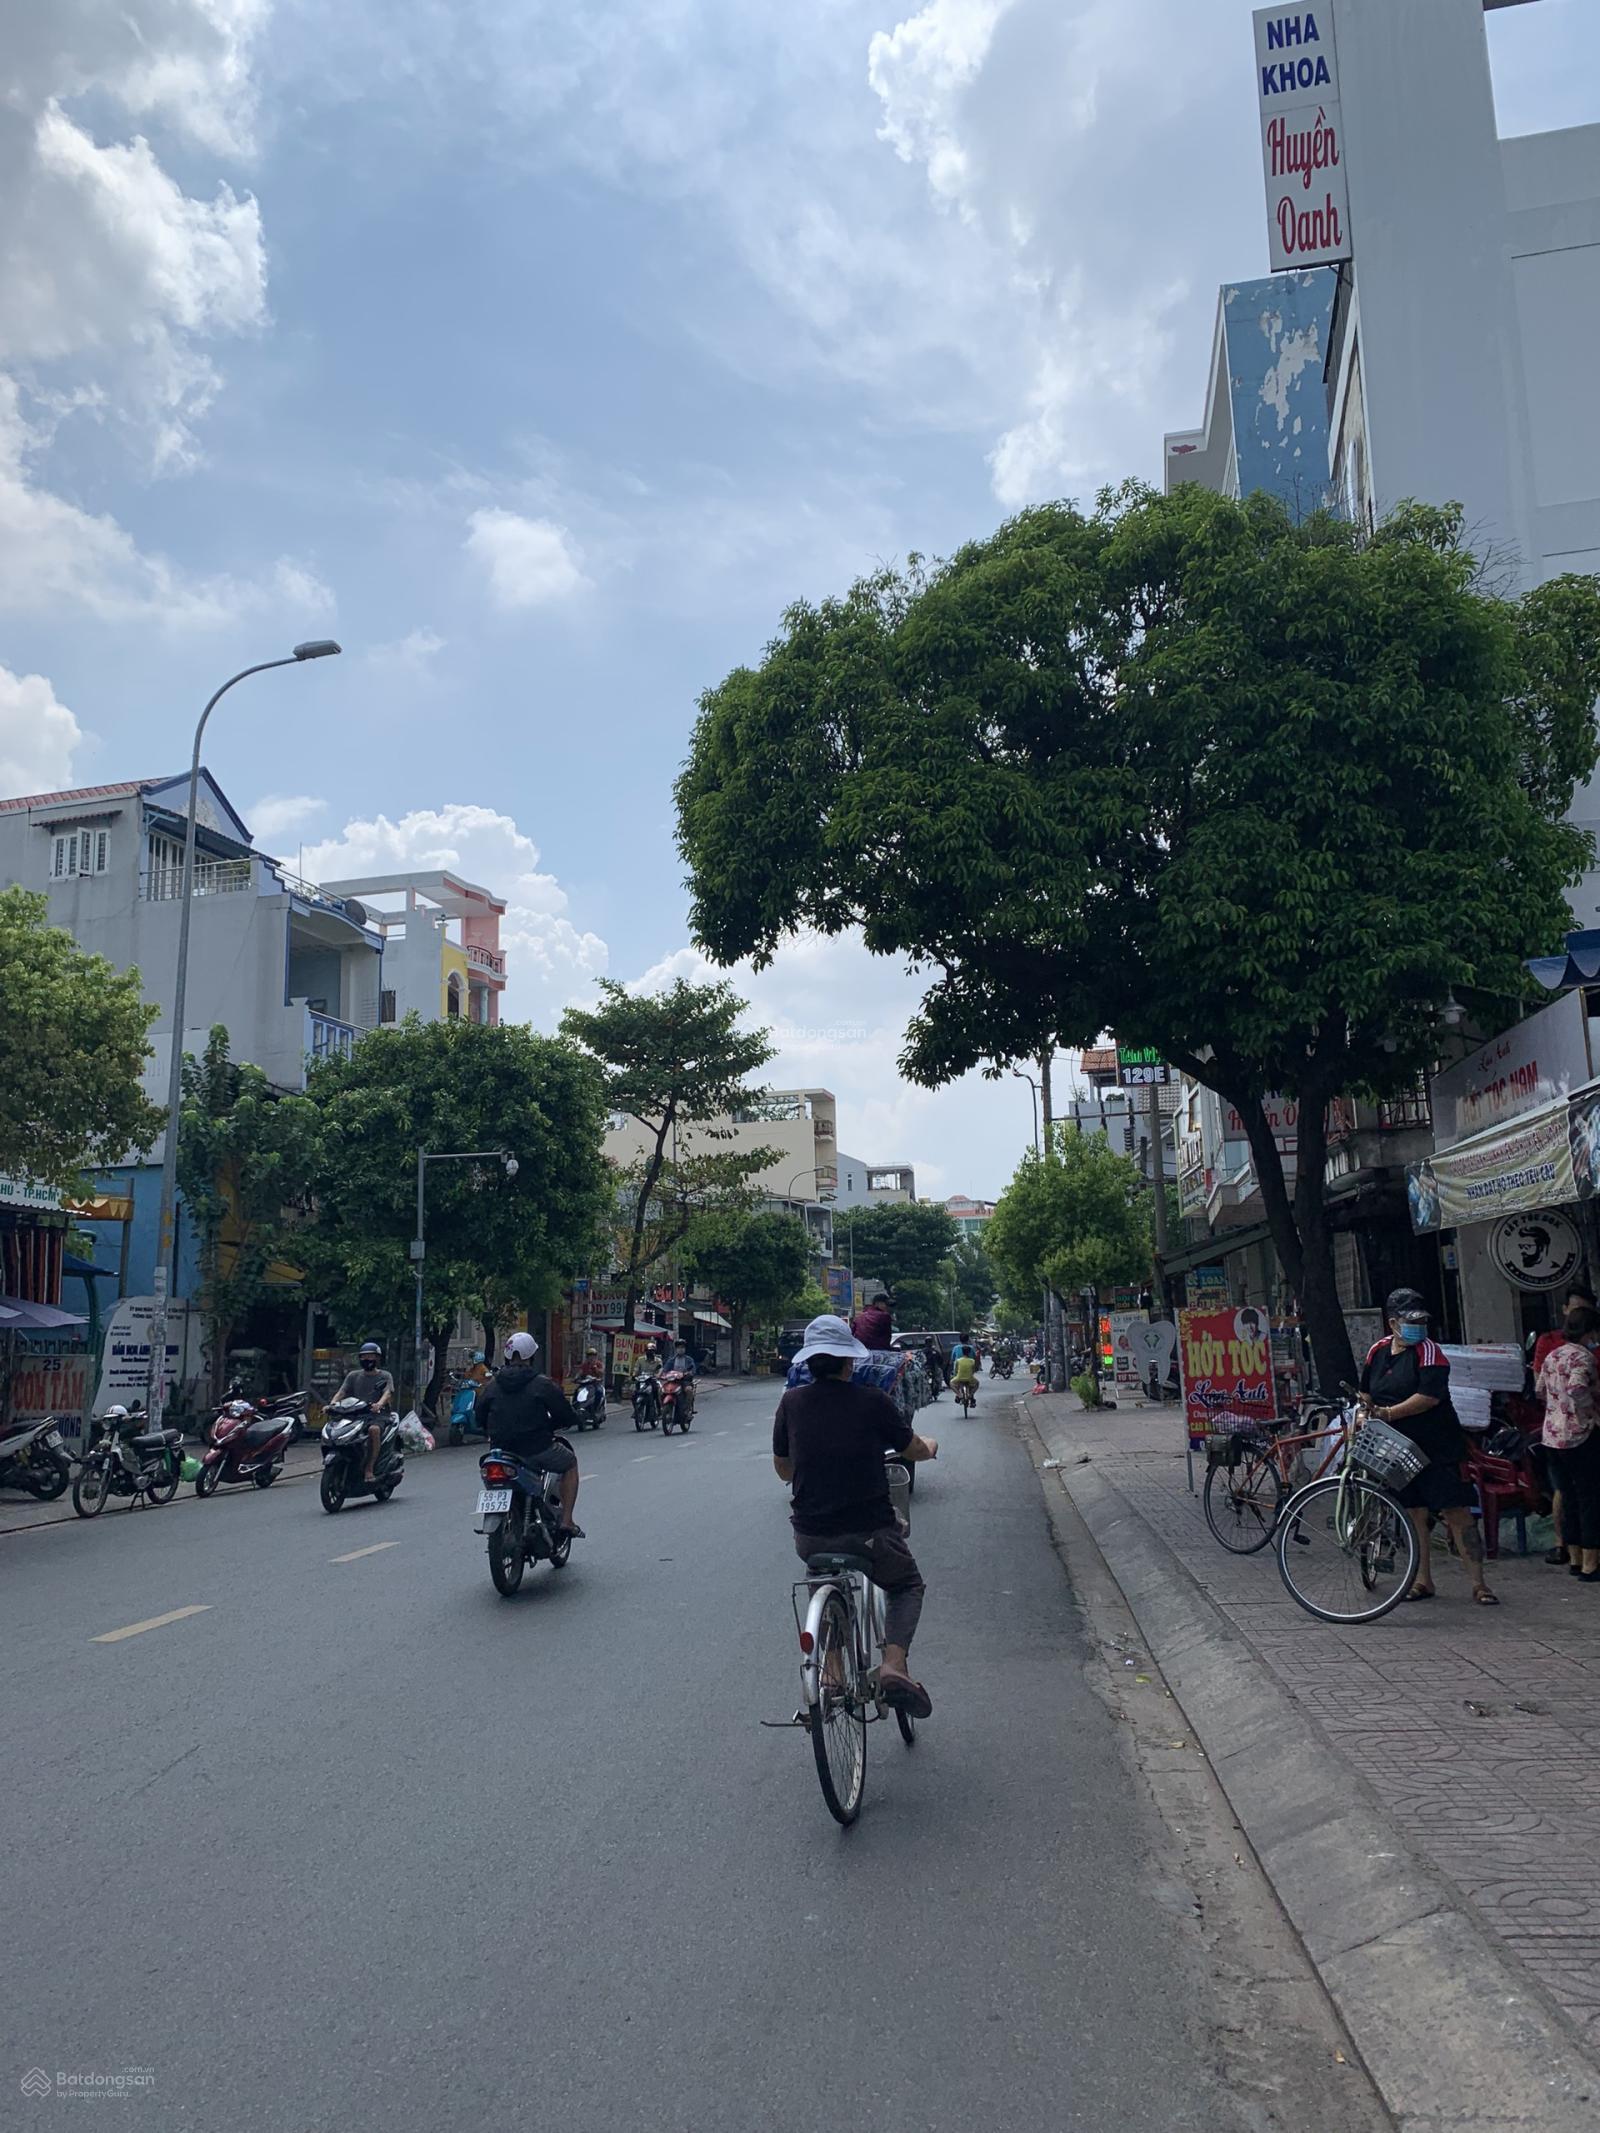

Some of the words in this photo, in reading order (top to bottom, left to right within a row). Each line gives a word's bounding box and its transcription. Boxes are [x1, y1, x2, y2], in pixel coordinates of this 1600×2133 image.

[1266, 13, 1320, 50] NHA
[1262, 56, 1331, 96] KHOA
[1267, 106, 1339, 189] Huyền
[1277, 193, 1343, 254] Oanh
[1509, 1060, 1539, 1101] NAM
[43, 1359, 61, 1371] 25
[1186, 1330, 1225, 1378] HỚT
[483, 1491, 507, 1501] 59-P3
